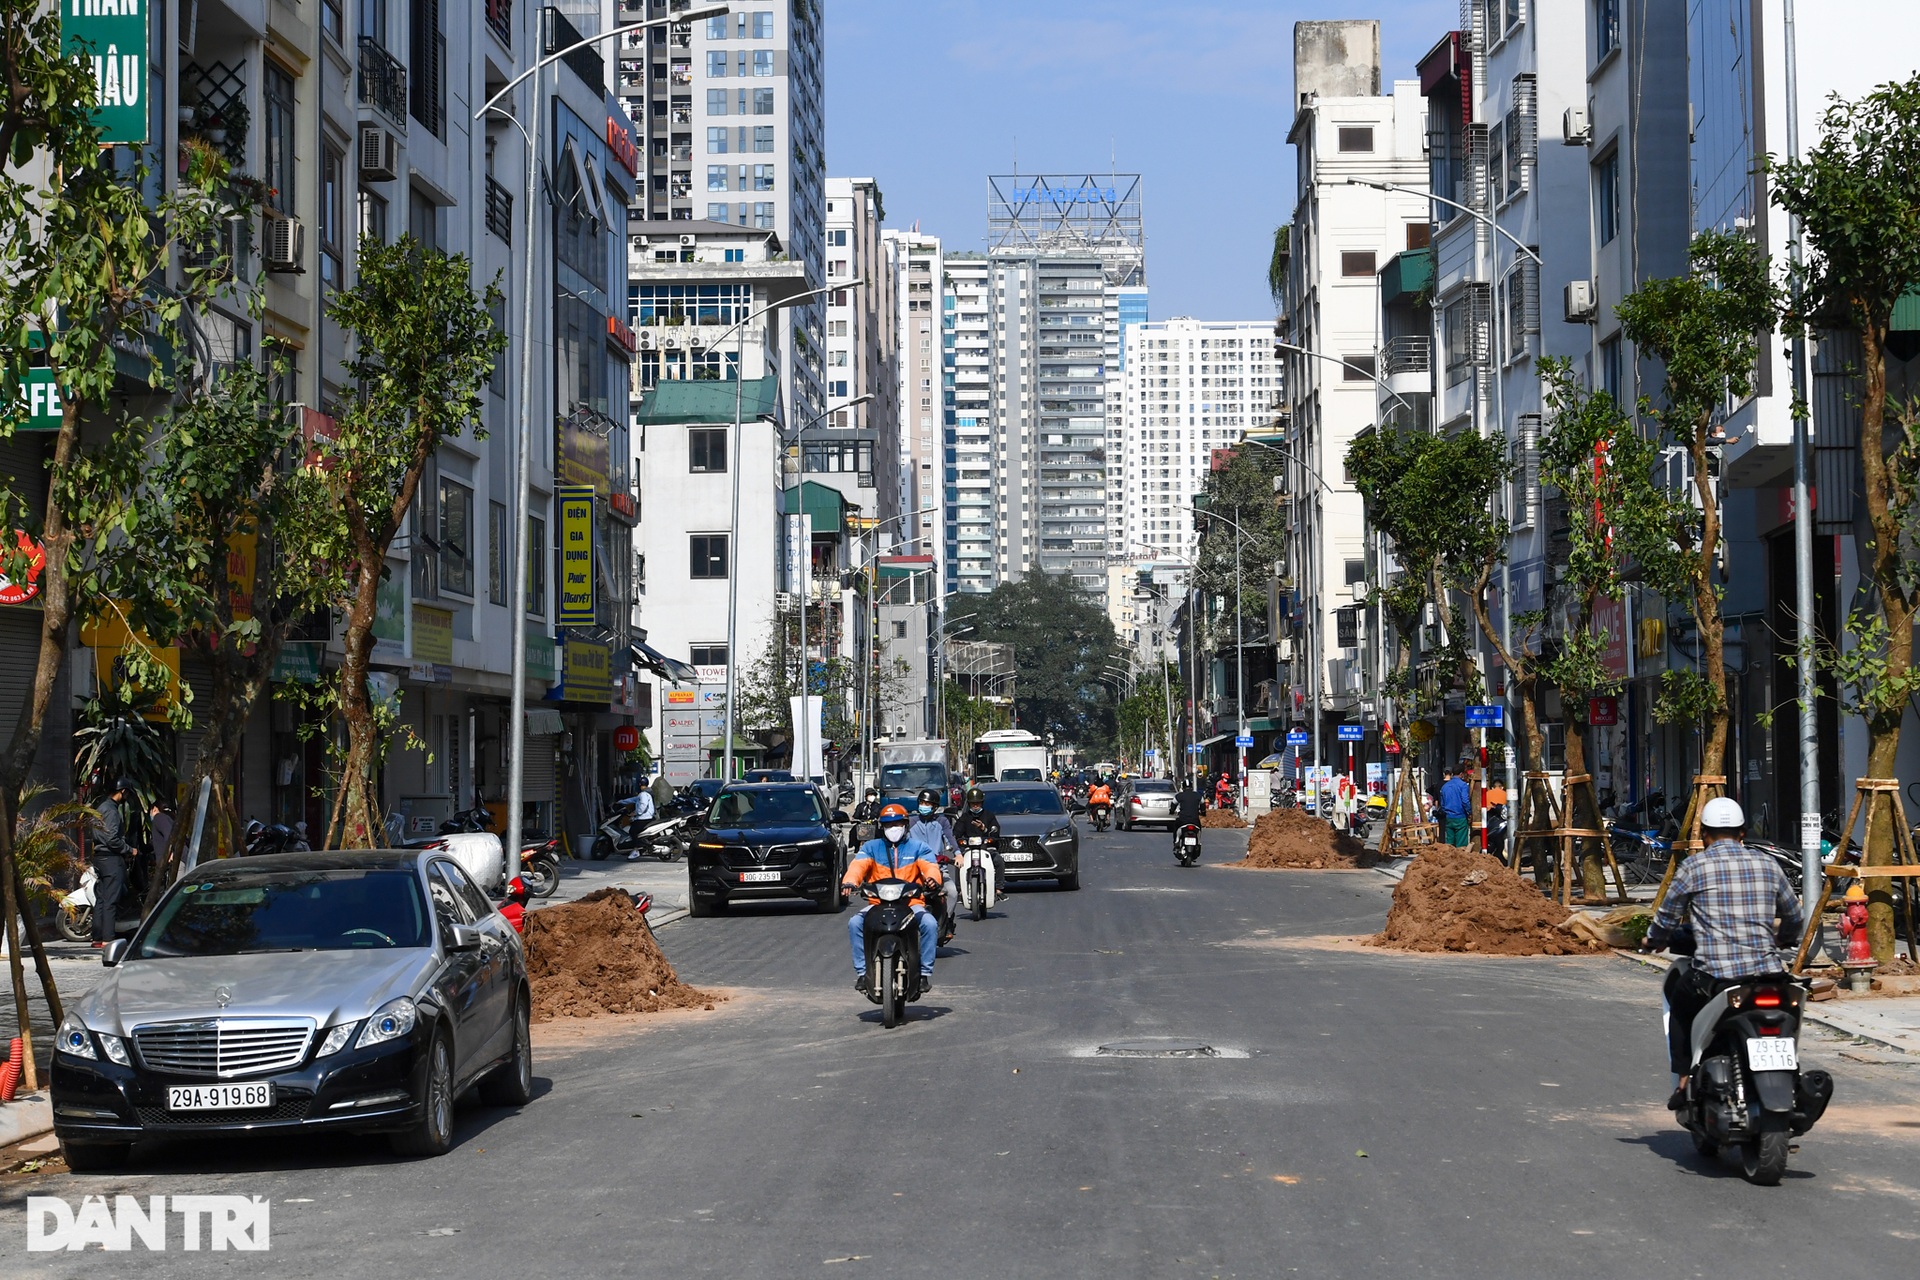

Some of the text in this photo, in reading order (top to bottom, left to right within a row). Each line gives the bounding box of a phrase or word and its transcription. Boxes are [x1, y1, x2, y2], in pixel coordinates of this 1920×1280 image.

[1013, 188, 1117, 203] HANDICO 6
[567, 506, 587, 520] ĐIỆN
[569, 531, 584, 541] GIA
[786, 534, 810, 543] CHA
[566, 550, 588, 562] DỤNG
[786, 563, 811, 572] CHU
[702, 668, 727, 676] TOWE
[172, 1085, 268, 1109] 29A-919.68
